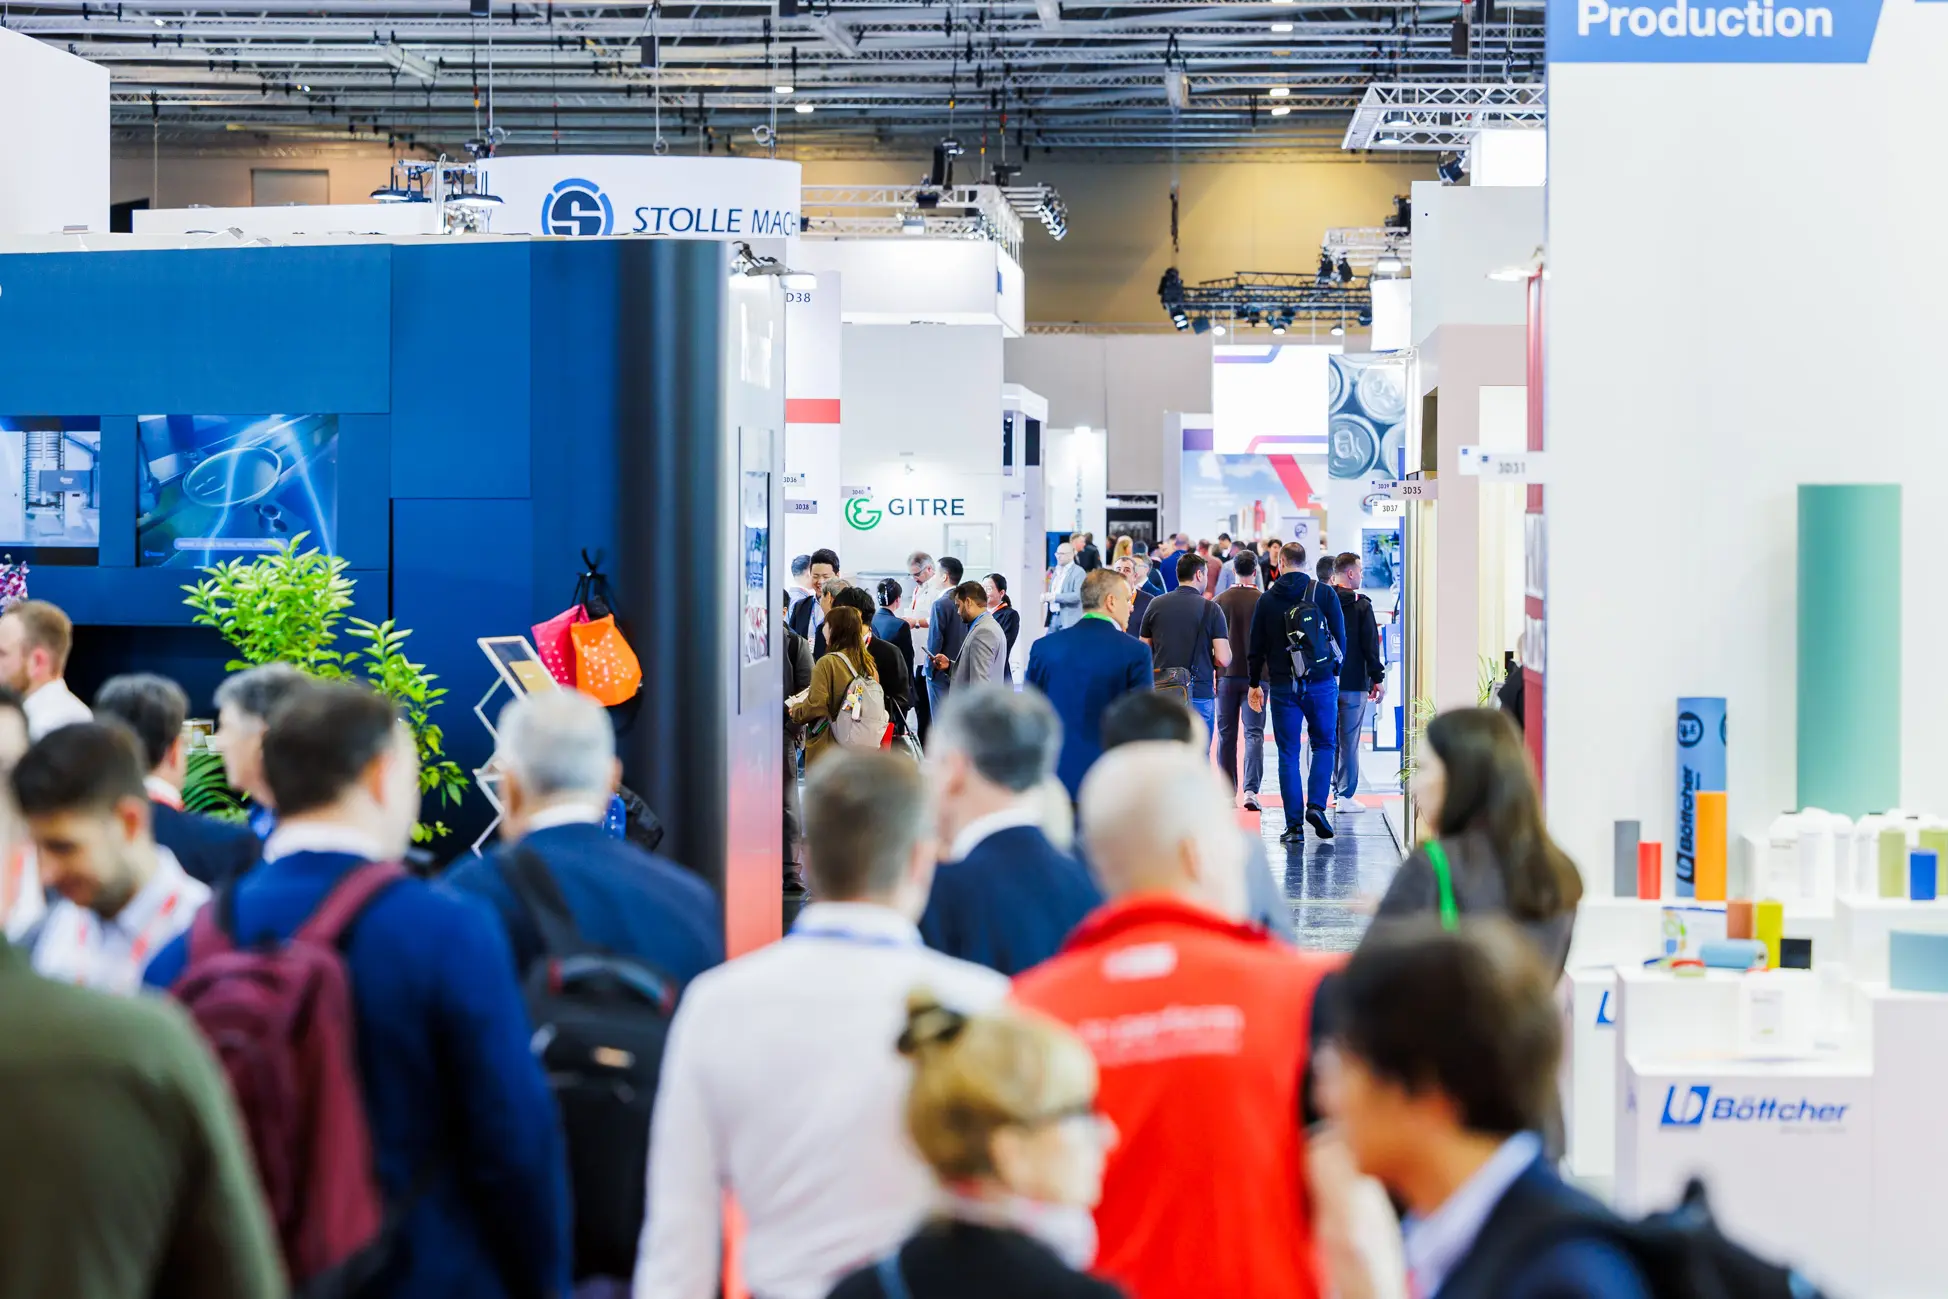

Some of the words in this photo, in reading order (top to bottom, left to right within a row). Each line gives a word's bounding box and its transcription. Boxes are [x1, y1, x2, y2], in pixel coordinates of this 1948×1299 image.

[1578, 0, 1833, 37] Production
[633, 207, 743, 233] STOLLE
[1403, 486, 1422, 494] 3D35
[888, 498, 965, 516] GITRE
[1382, 504, 1398, 512] 3D37
[1712, 1096, 1849, 1122] Böttcher
